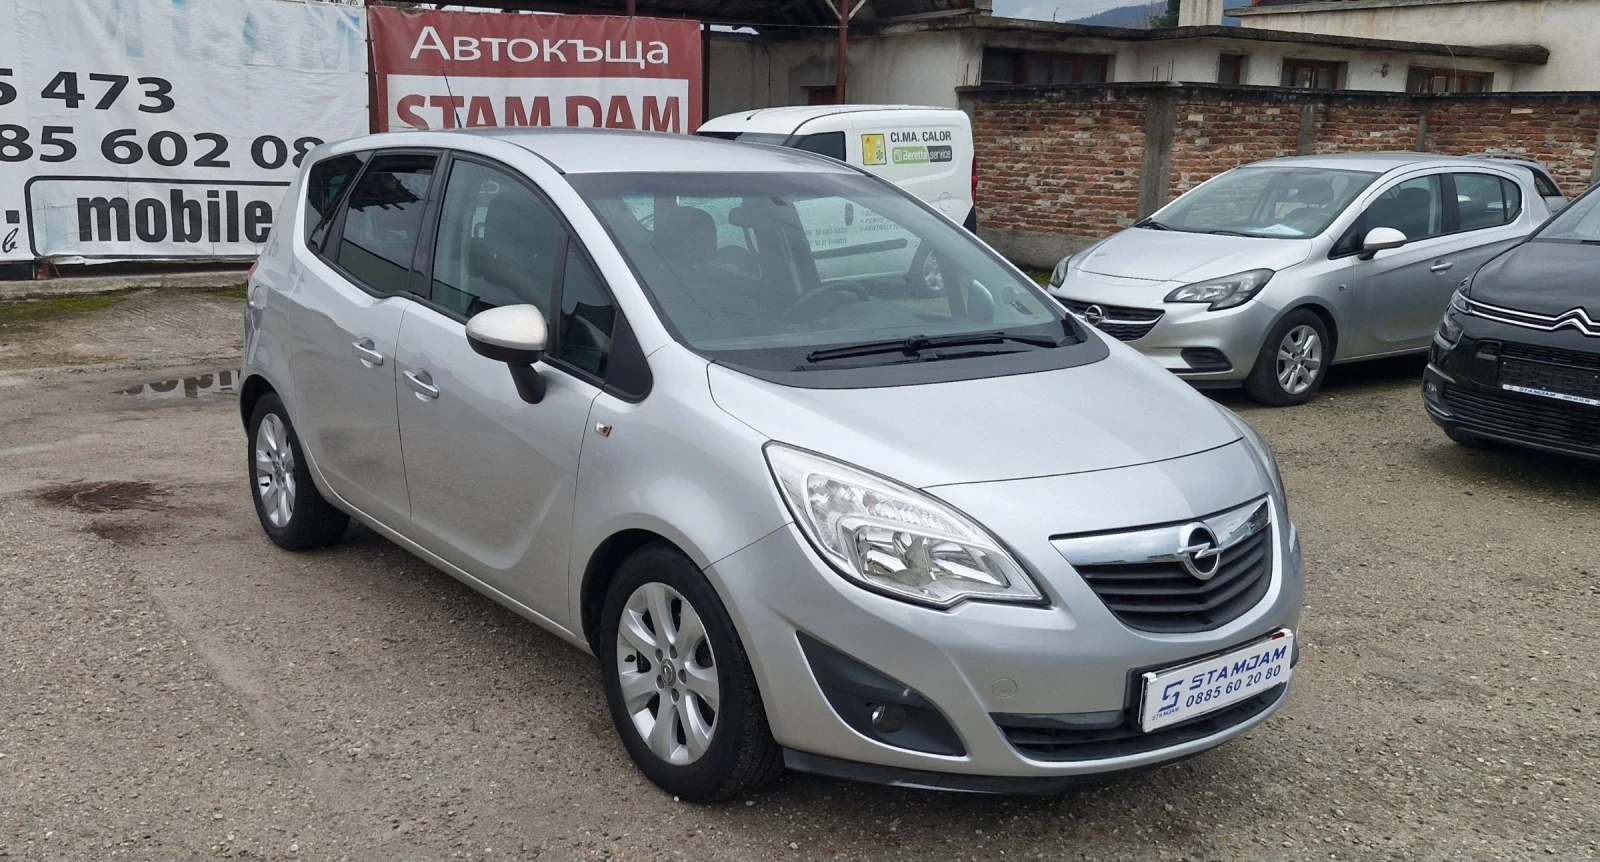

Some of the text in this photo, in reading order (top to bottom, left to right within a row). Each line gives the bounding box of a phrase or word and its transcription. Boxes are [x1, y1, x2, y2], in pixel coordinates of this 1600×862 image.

[410, 26, 669, 69] Автокъща
[41, 71, 175, 113] 473
[396, 94, 681, 134] STAM DAM
[101, 129, 231, 169] 602
[890, 130, 952, 143] CI.MA. CALOR
[902, 149, 951, 161] Beretta service
[77, 189, 273, 243] mobile
[1186, 664, 1281, 708] 0885 60 20 80
